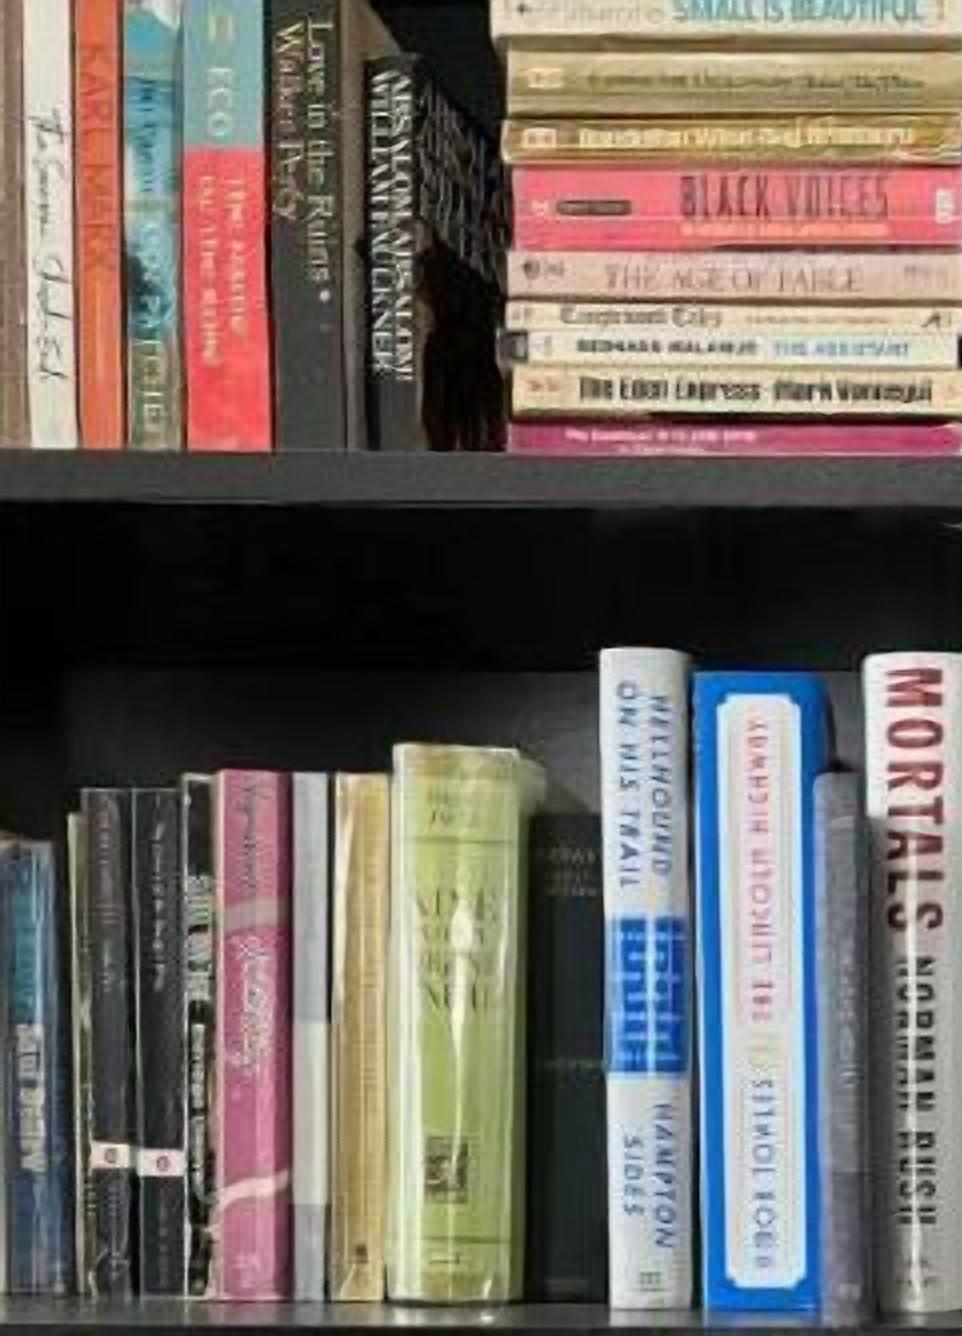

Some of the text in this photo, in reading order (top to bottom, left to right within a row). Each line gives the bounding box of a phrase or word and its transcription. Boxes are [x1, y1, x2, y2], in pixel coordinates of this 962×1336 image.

[206, 66, 236, 139] ECO
[307, 138, 335, 186] the
[680, 176, 769, 219] BLACK
[617, 679, 643, 889] ON HIS TRAIL
[650, 692, 674, 877] HELLHOUND
[885, 666, 945, 932] MORTALS
[897, 955, 938, 1227] NORMAN RUSH
[622, 1136, 644, 1218] SIDES
[651, 1102, 678, 1250] HAMPTON
